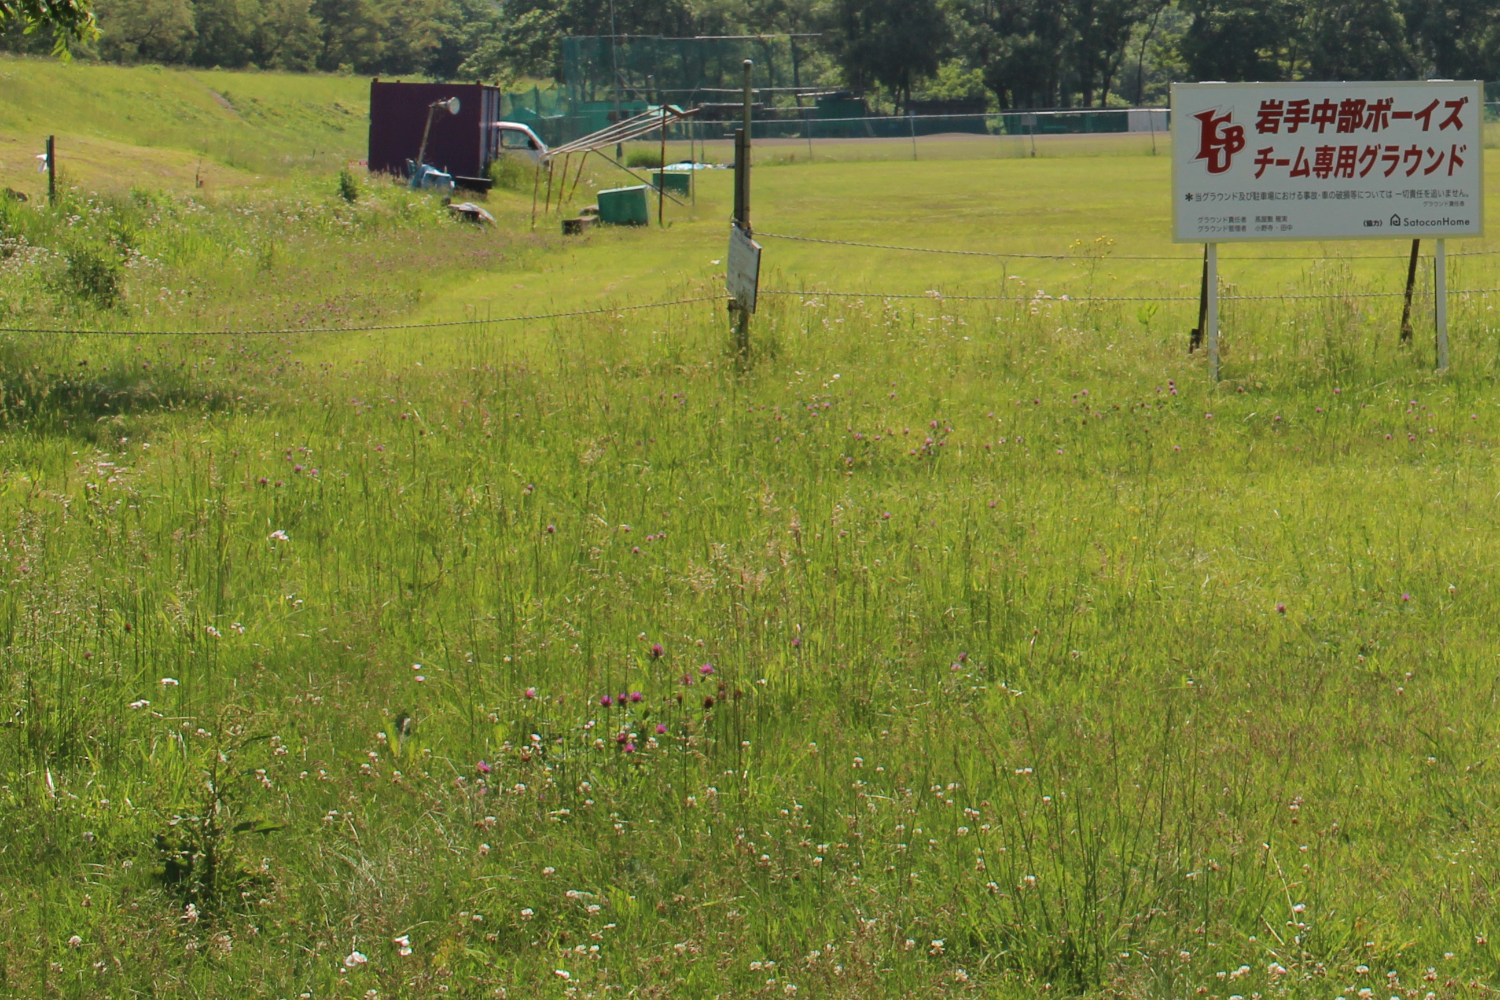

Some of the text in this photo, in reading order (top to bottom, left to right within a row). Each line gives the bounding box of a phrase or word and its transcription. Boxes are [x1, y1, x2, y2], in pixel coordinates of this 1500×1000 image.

[1255, 96, 1469, 135] 岩手中部ボーイズ
[1254, 144, 1468, 179] チーム専用グラウンド
[1403, 217, 1471, 228] SatoconHome
